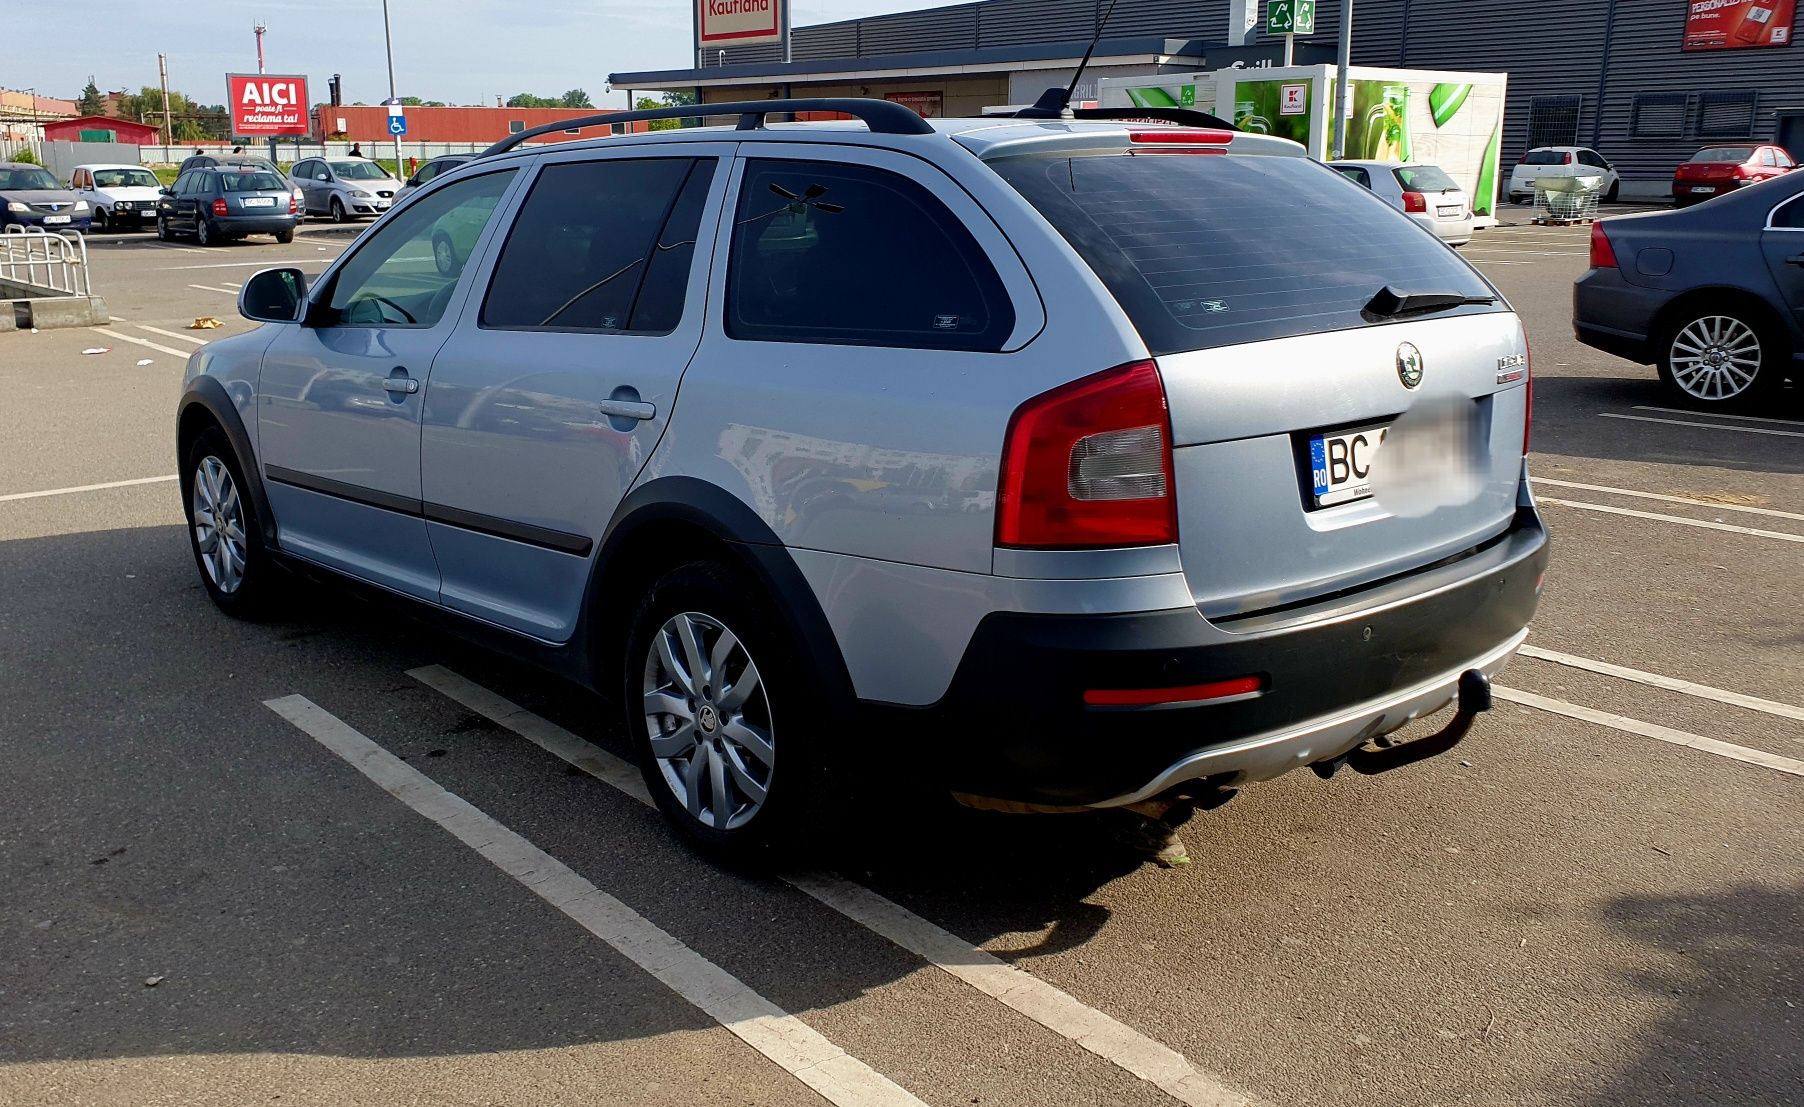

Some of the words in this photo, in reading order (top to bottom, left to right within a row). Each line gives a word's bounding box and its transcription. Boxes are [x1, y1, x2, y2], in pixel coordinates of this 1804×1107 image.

[709, 0, 769, 16] Kaufland
[242, 82, 297, 105] AICI
[243, 114, 282, 123] reclama
[283, 113, 299, 123] ta!
[255, 105, 275, 113] poate
[1328, 434, 1370, 486] BC
[1313, 468, 1327, 488] RO
